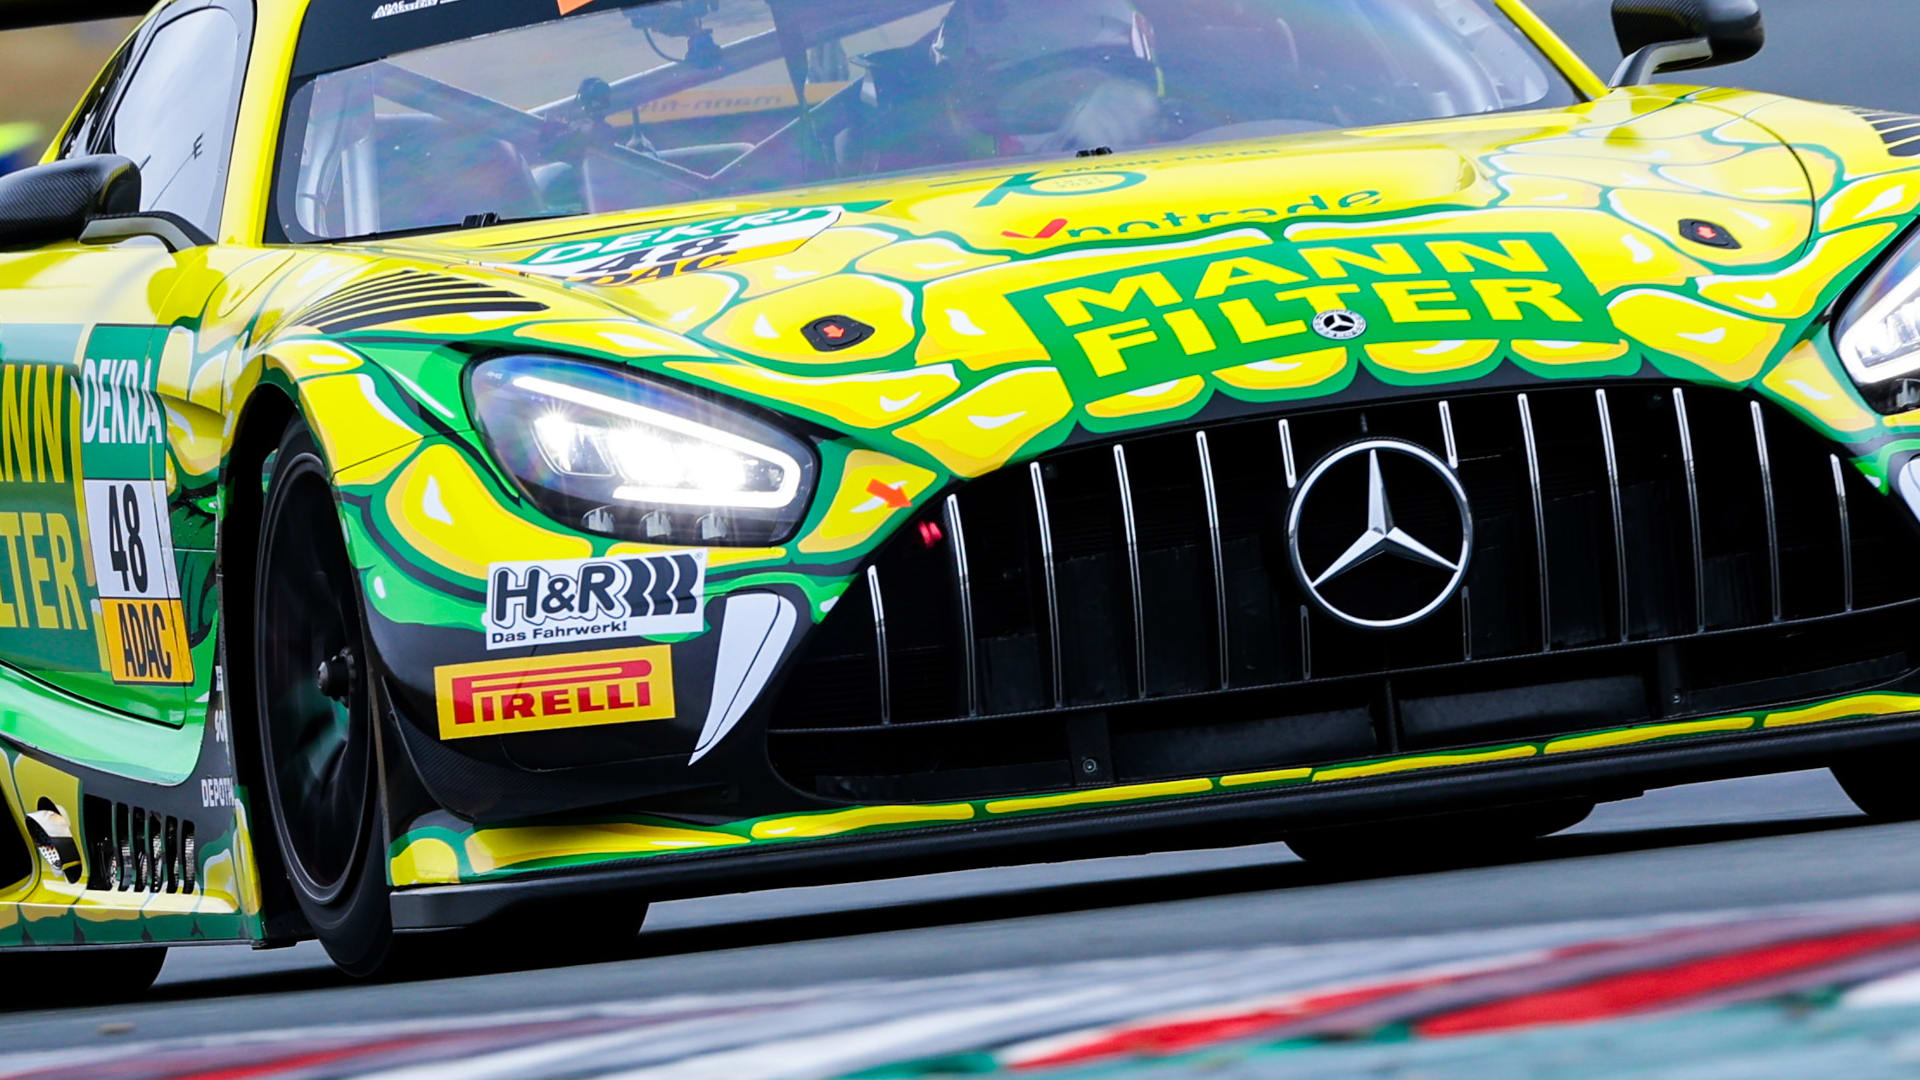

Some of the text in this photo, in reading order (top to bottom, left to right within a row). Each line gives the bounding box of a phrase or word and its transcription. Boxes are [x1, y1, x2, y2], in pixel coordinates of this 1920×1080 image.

[575, 233, 741, 273] 48
[1043, 239, 1549, 327] MANN
[1073, 278, 1584, 378] FILTER
[82, 358, 163, 444] DEKRA
[109, 483, 148, 593] 48
[491, 620, 628, 645] Das Fahrwerk!
[493, 563, 621, 626] H&R
[118, 603, 172, 680] ADAC
[452, 659, 652, 725] PIRELLI
